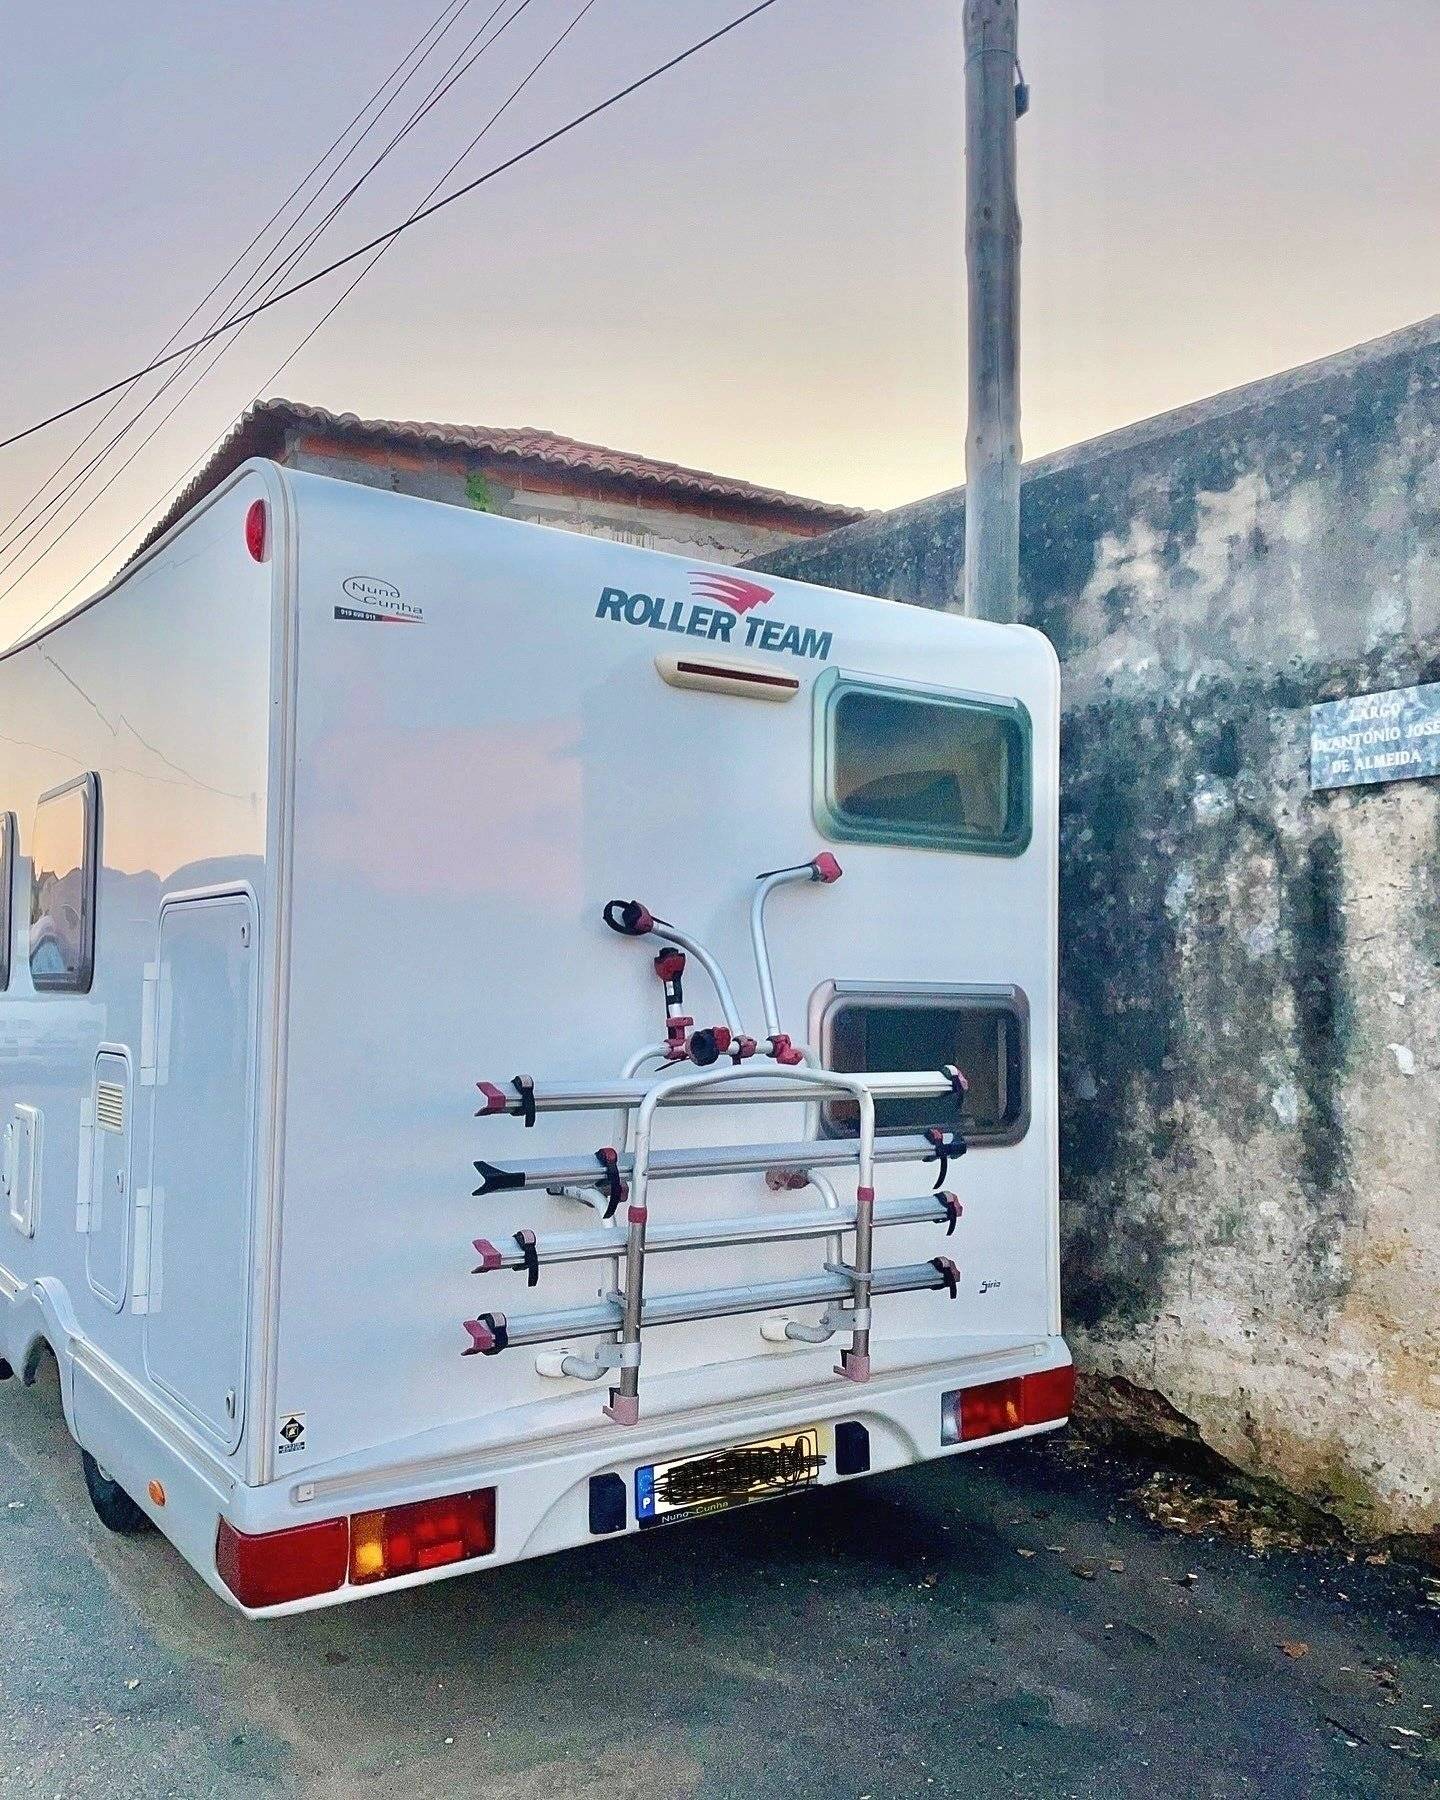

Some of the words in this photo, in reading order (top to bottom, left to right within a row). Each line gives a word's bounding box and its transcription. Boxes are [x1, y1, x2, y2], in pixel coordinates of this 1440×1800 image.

[352, 581, 400, 598] Nuno
[364, 596, 423, 615] Cunha
[595, 586, 737, 643] ROLLER
[745, 615, 833, 661] TEAM
[1331, 759, 1350, 774] DE
[1355, 749, 1422, 771] ALMEIDA
[643, 1497, 651, 1510] P
[661, 1511, 689, 1523] Nuno
[696, 1501, 729, 1514] Cunha
